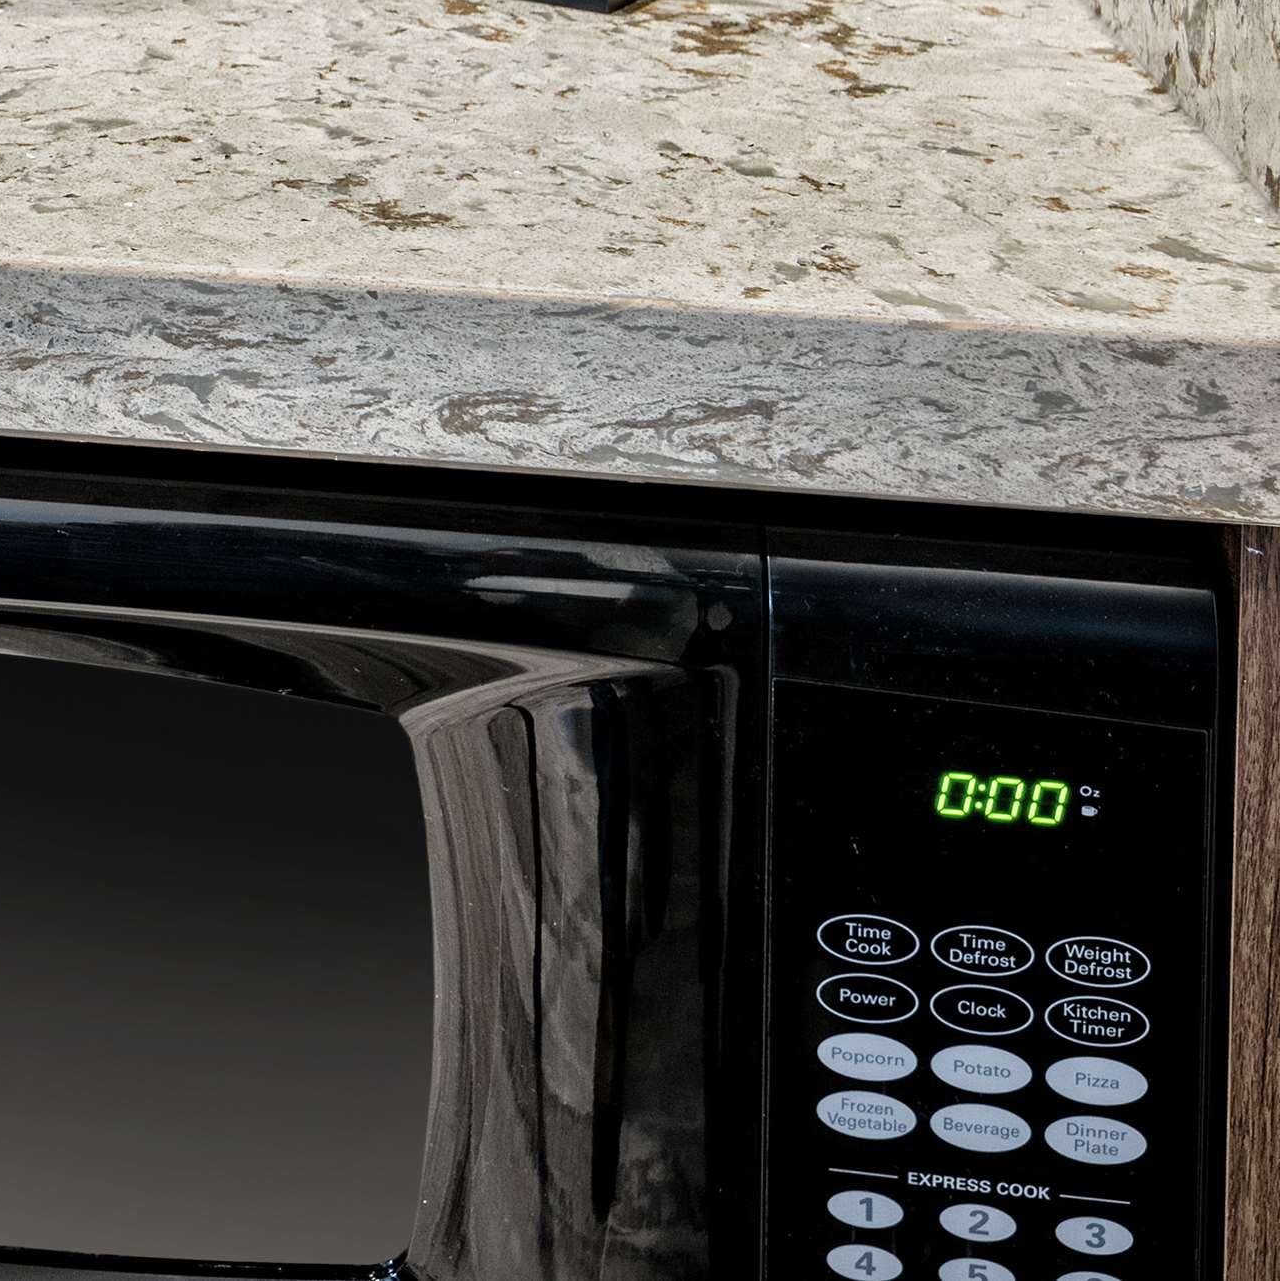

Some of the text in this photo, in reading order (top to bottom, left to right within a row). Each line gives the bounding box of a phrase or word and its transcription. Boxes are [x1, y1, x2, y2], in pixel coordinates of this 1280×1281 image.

[937, 772, 1068, 825] 0:00
[845, 922, 892, 940] Time
[845, 939, 892, 956] Cook
[959, 933, 1006, 951] Time
[949, 948, 1016, 968] Defrost
[1065, 943, 1131, 964] Weight
[1064, 959, 1132, 979] Defrost
[839, 988, 896, 1007] Power
[957, 1000, 1006, 1019] Clock
[1063, 1002, 1131, 1023] Kitchen
[1069, 1019, 1125, 1038] Timer
[831, 1046, 905, 1067] Popcorn
[954, 1060, 1011, 1079] Potato
[1075, 1072, 1120, 1090] Pizza
[841, 1097, 894, 1116] Frozen
[827, 1112, 907, 1133] Vegetable
[943, 1117, 1020, 1140] Beverage
[1066, 1122, 1128, 1141] Dinner
[1074, 1139, 1119, 1156] Plate
[907, 1172, 1051, 1200] EXPRESS COOK
[858, 1197, 873, 1222] 1
[968, 1209, 990, 1236] 2
[1085, 1222, 1106, 1249] 3
[854, 1251, 876, 1276] 4
[968, 1264, 988, 1281] 5
